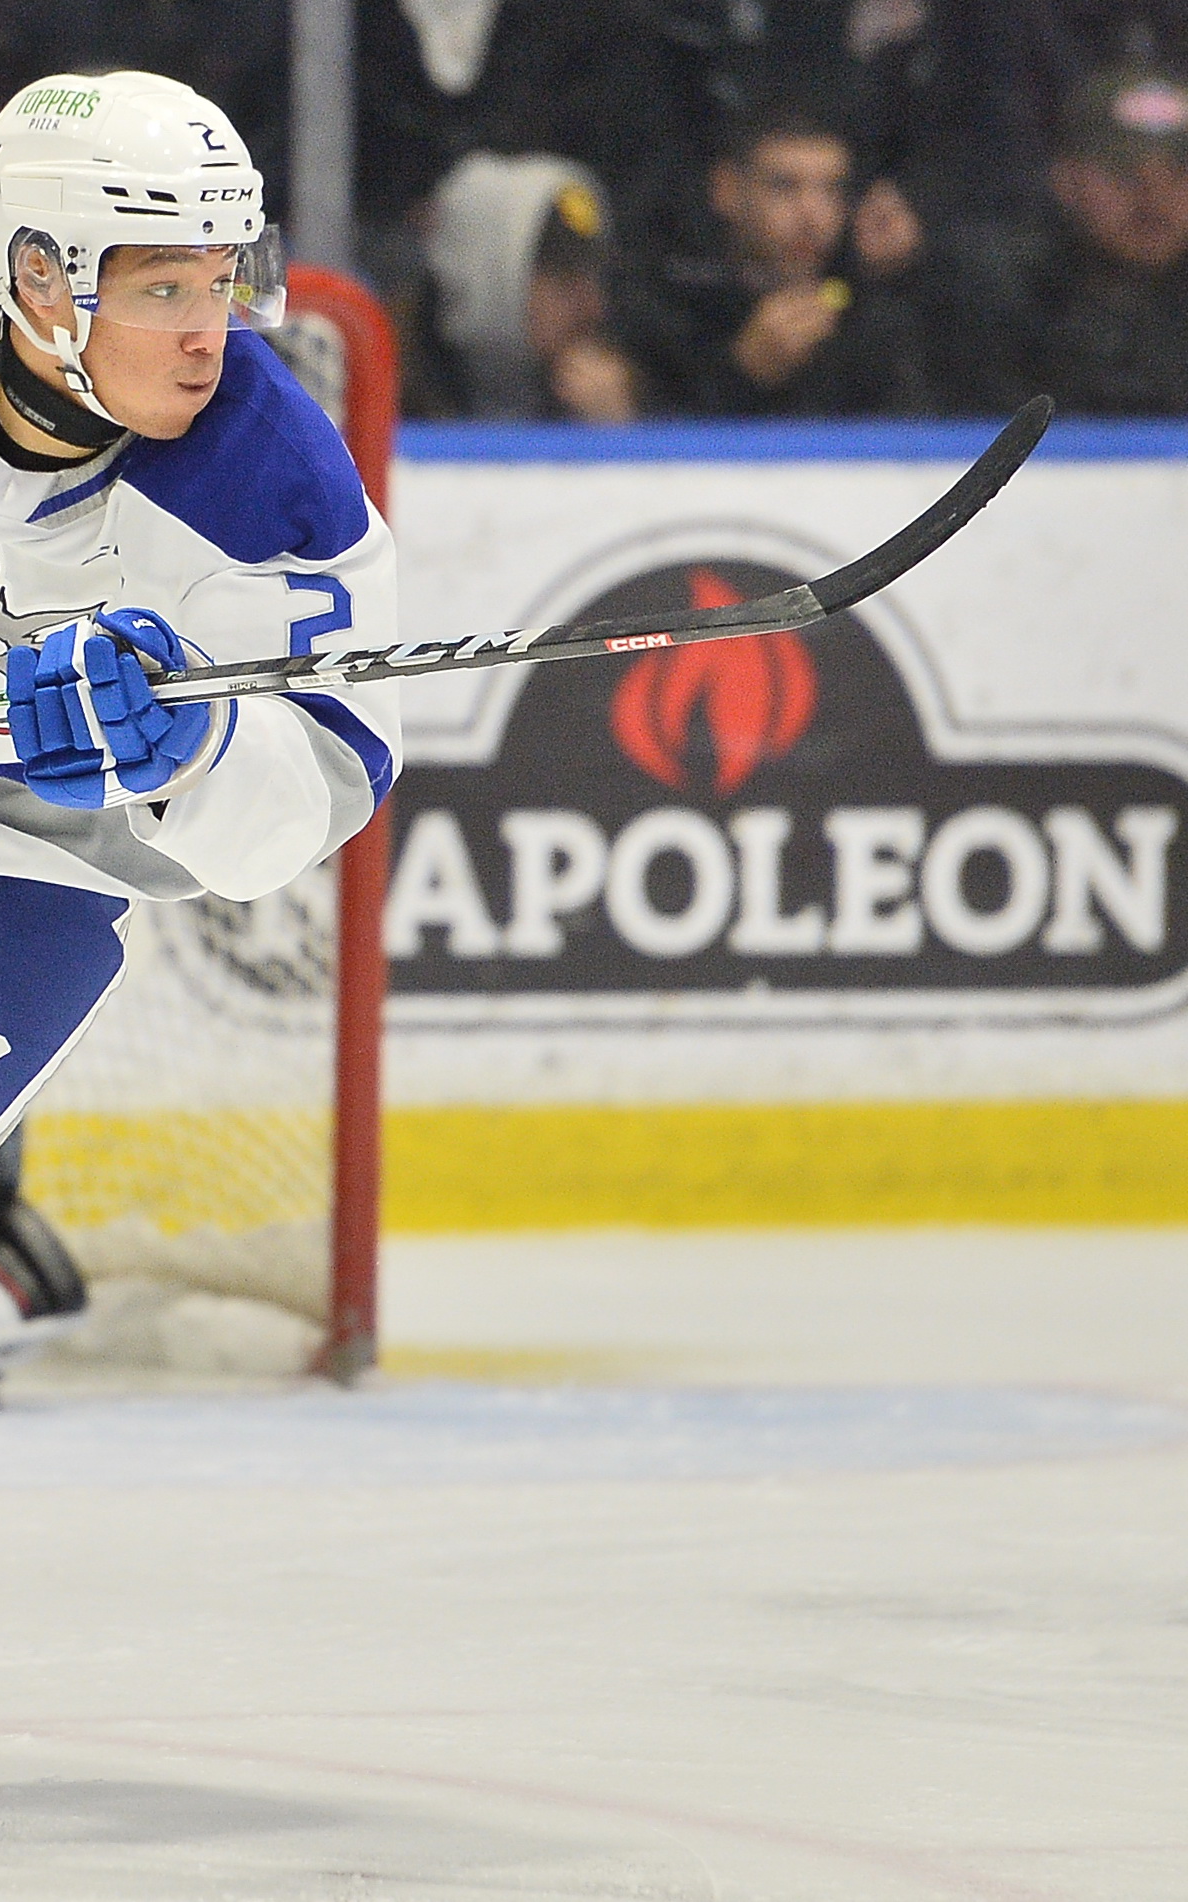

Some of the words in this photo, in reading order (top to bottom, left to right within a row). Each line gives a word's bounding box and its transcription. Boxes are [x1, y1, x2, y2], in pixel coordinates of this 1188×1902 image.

[16, 89, 101, 119] TOPPER'S
[28, 118, 60, 131] PIZZA
[188, 122, 227, 150] 2
[200, 188, 254, 202] CCM
[313, 624, 563, 674] CCM
[610, 634, 670, 651] CCM
